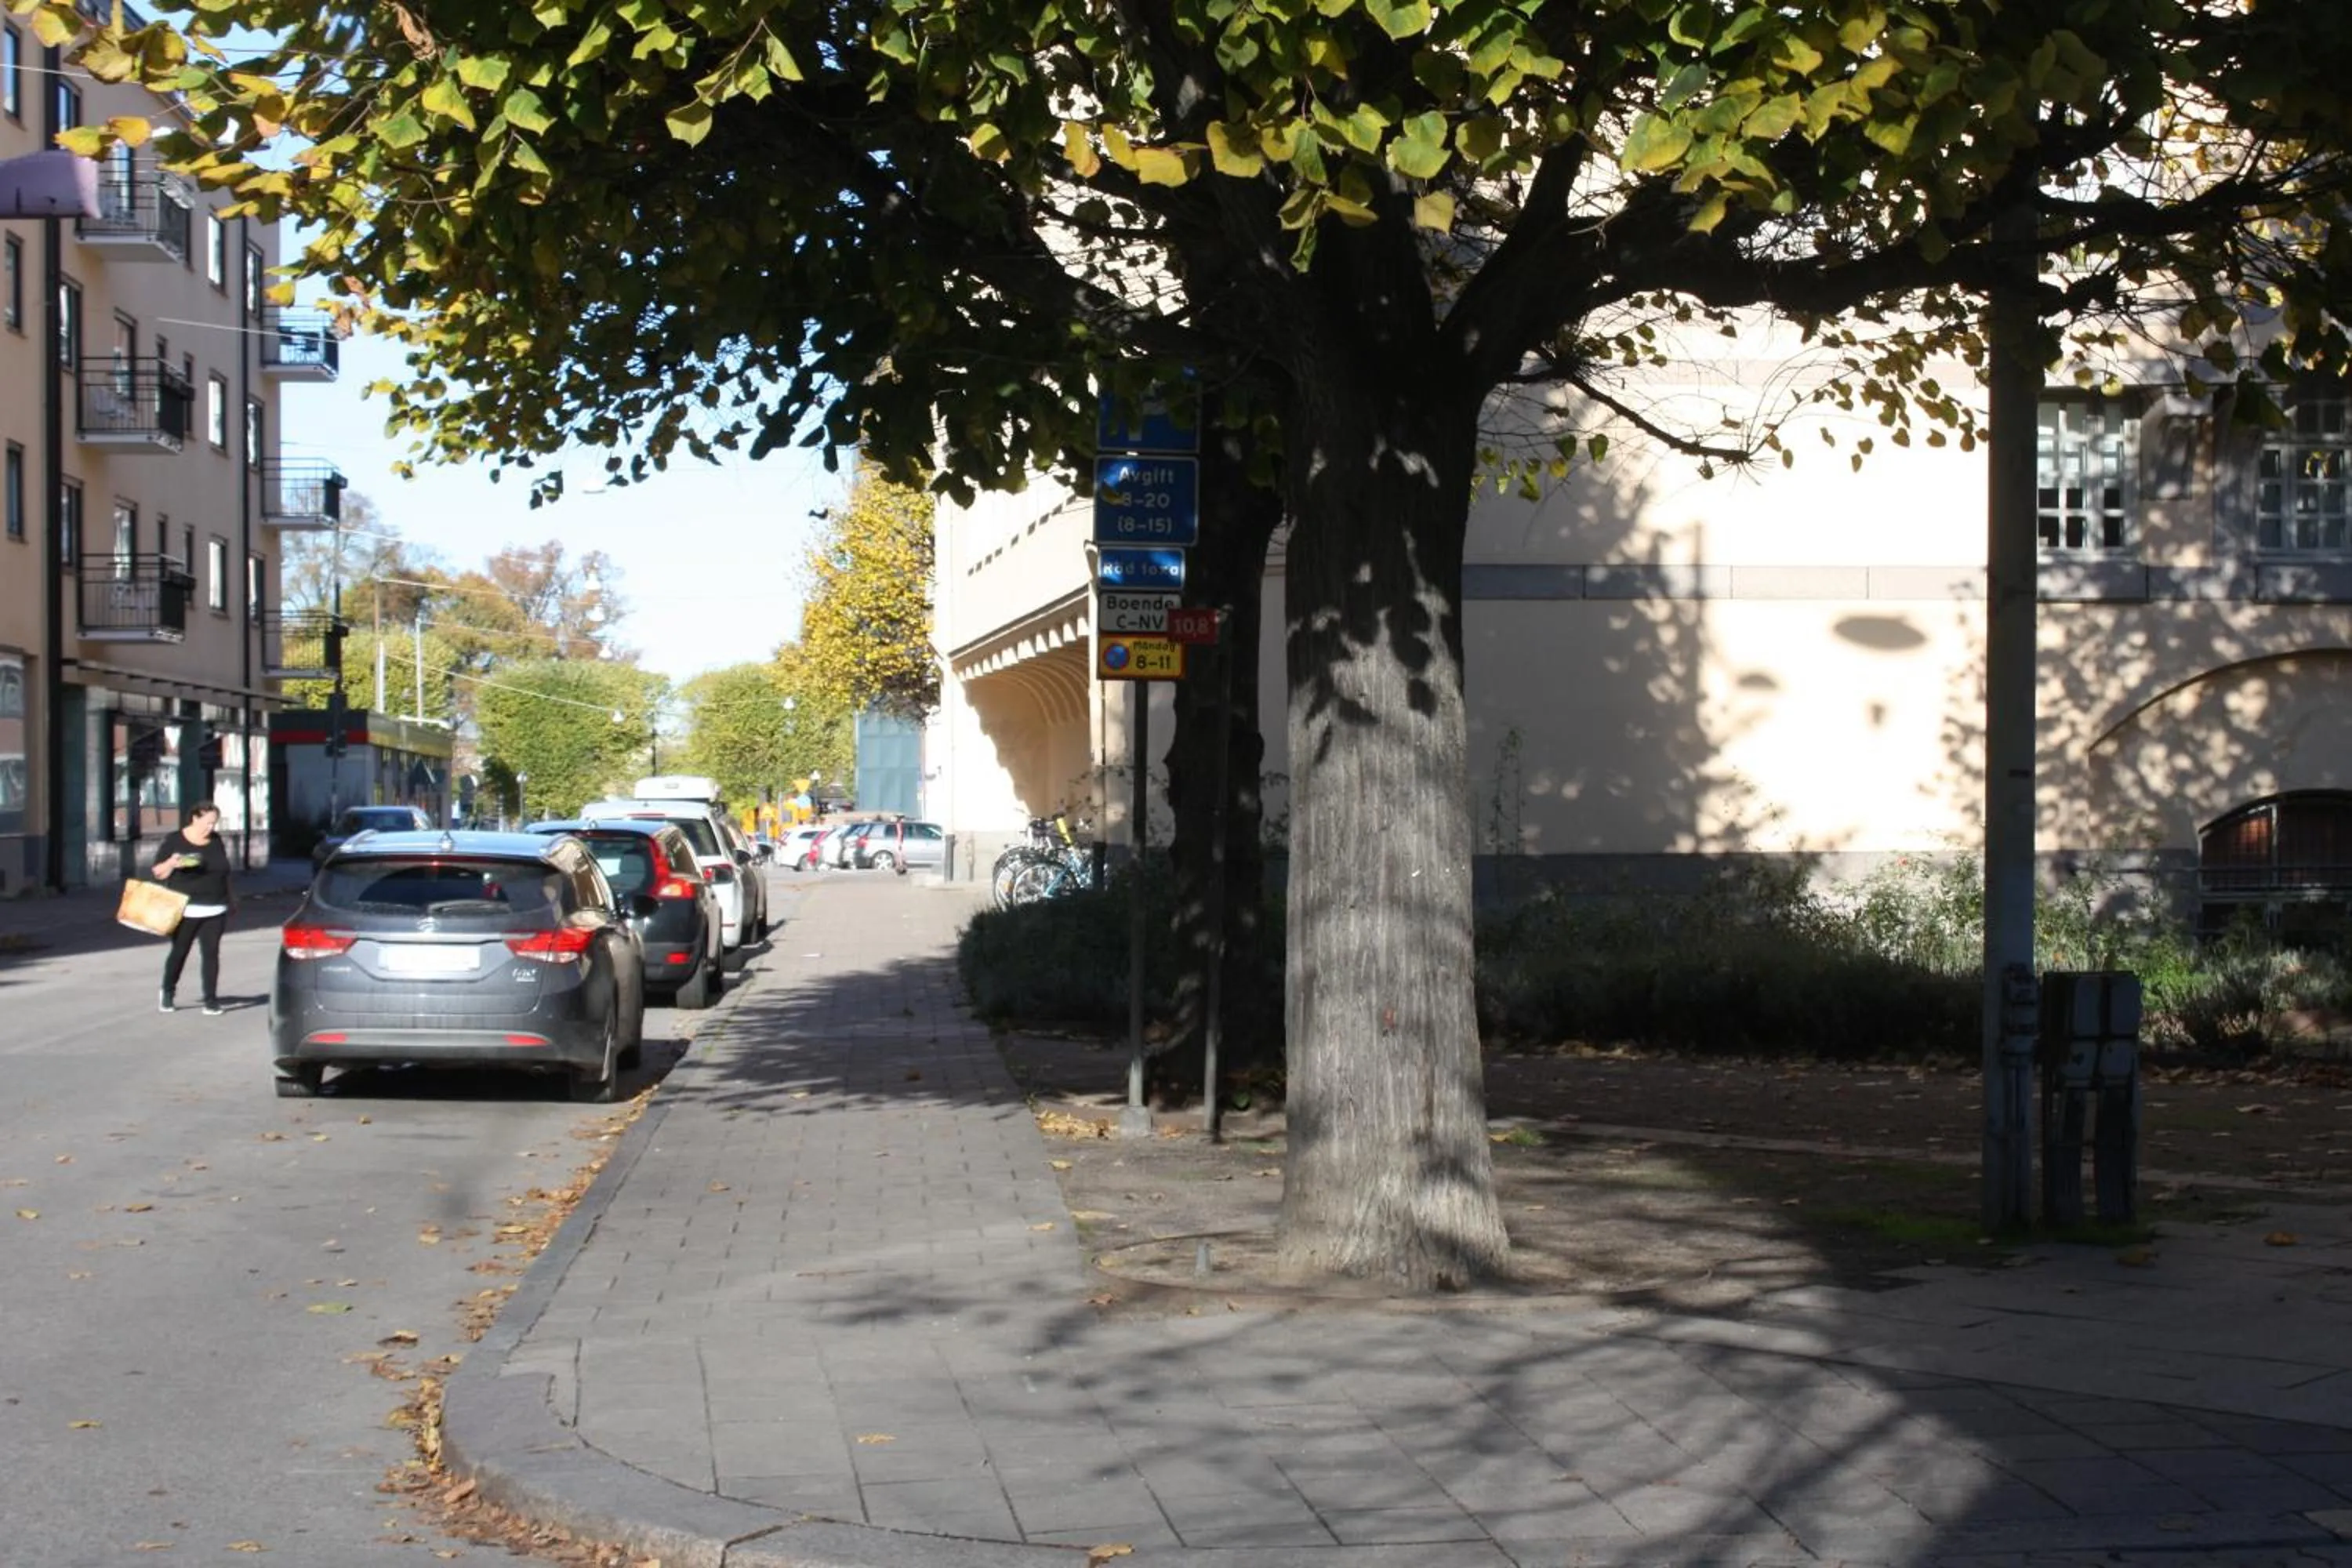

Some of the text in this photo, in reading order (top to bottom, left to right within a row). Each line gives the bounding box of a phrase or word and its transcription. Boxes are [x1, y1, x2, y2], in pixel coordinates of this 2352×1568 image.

[1119, 466, 1174, 485] Avgift
[1117, 515, 1173, 534] (8-15)
[1107, 596, 1174, 610] Boende
[1116, 615, 1163, 629] C-NV
[1135, 655, 1171, 670] 8-11
